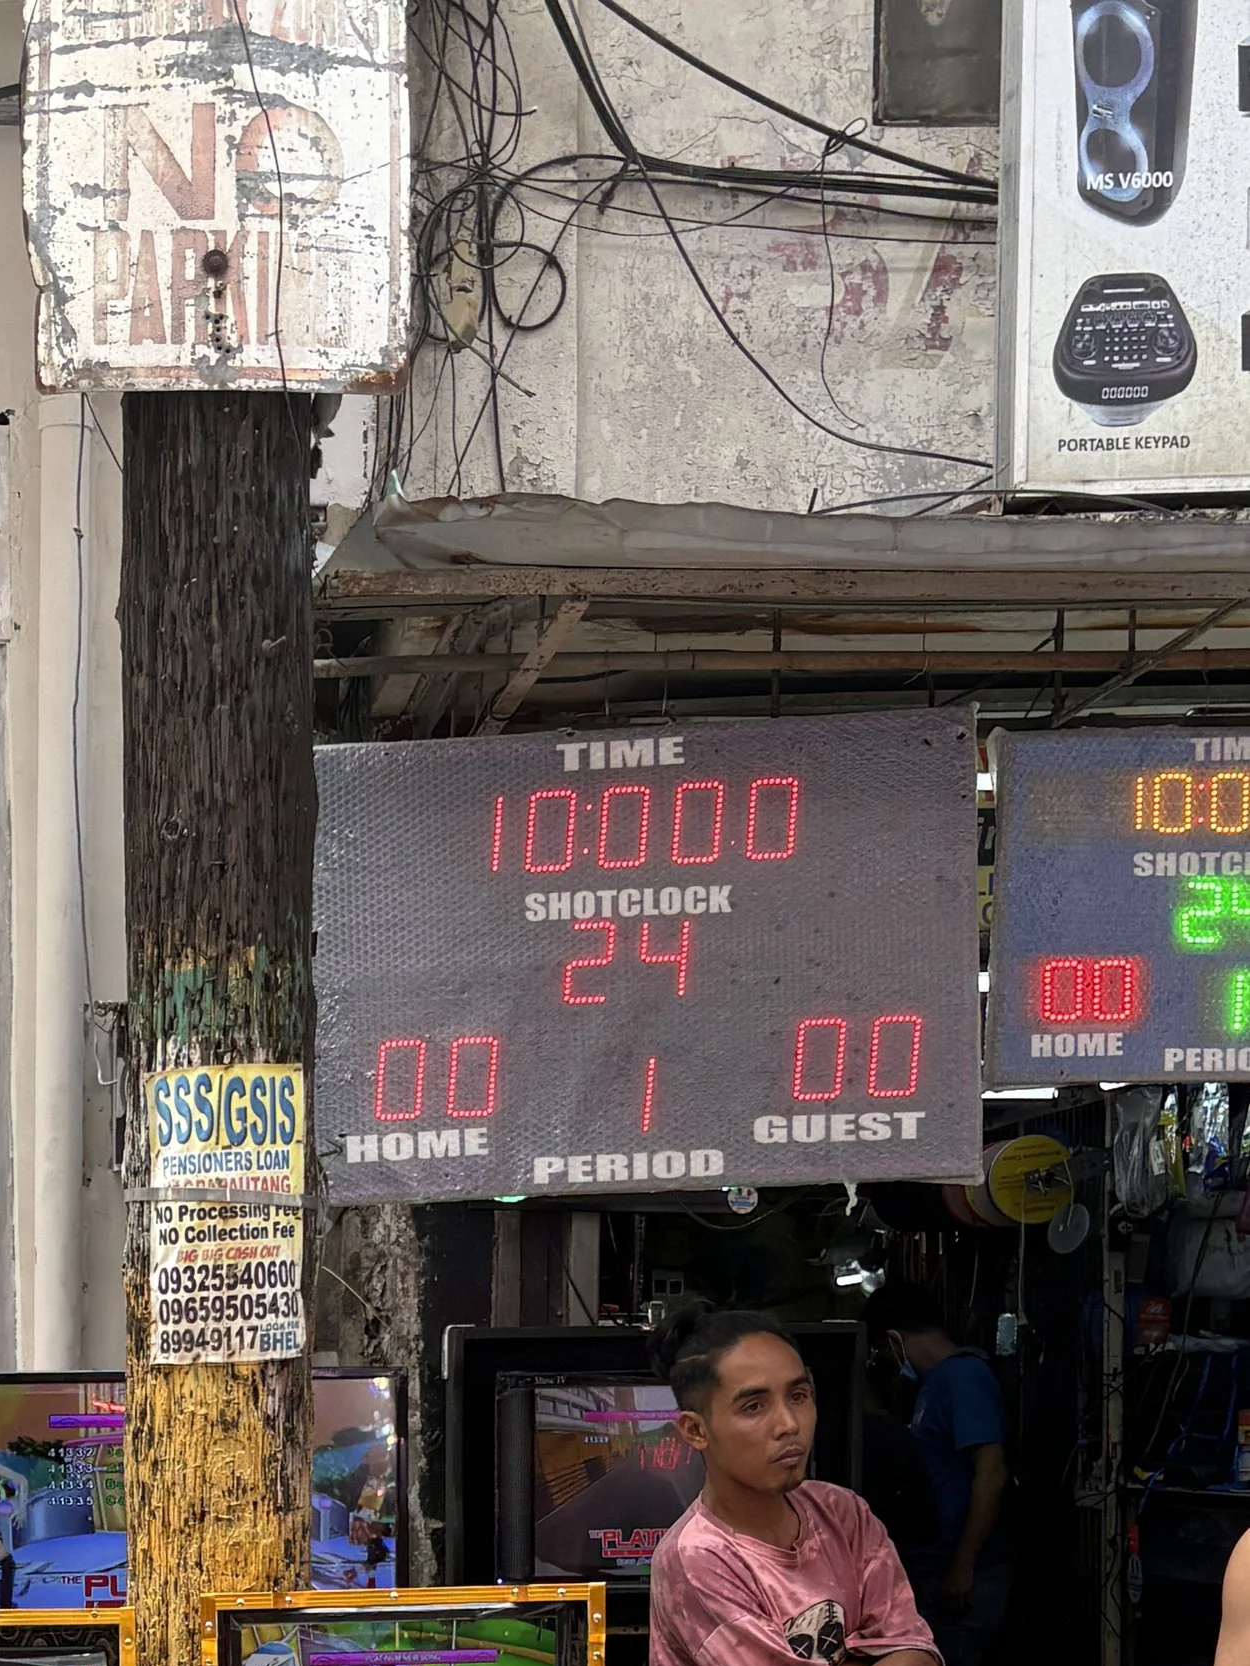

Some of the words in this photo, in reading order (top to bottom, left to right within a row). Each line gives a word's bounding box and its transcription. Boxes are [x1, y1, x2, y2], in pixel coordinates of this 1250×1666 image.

[104, 102, 345, 220] NO
[1086, 173, 1115, 191] MS
[1118, 170, 1174, 190] V6000
[1101, 385, 1149, 399] 000000
[1057, 437, 1131, 453] PORTABLE
[1134, 435, 1191, 450] KEYPAD
[556, 737, 685, 772] TIME
[525, 886, 732, 922] SHOTCLOCK
[563, 920, 690, 1005] 24
[1043, 958, 1132, 1021] 00
[1232, 973, 1245, 1031] 1
[792, 1015, 923, 1101] 00
[1031, 1033, 1124, 1058] HOME
[374, 1035, 498, 1122] 00
[640, 1057, 656, 1133] 1
[154, 1073, 296, 1147] SSS/GSIS
[346, 1127, 490, 1163] HOME
[753, 1111, 926, 1145] GUEST
[162, 1150, 253, 1177] PENSIONERS
[256, 1149, 291, 1170] LOAN
[533, 1149, 725, 1185] PERIOD
[155, 1206, 173, 1224] NO
[178, 1203, 271, 1222] Processing
[275, 1204, 300, 1217] Fee
[159, 1227, 180, 1245] NO
[184, 1223, 269, 1243] Collection
[272, 1221, 296, 1239] Fee
[177, 1250, 199, 1262] BIG
[201, 1248, 224, 1261] BIG
[225, 1246, 258, 1259] CASH
[158, 1260, 296, 1295] 09325540600
[159, 1291, 299, 1325] 09659505430
[259, 1331, 300, 1352] BHEL
[61, 1575, 82, 1585] THE
